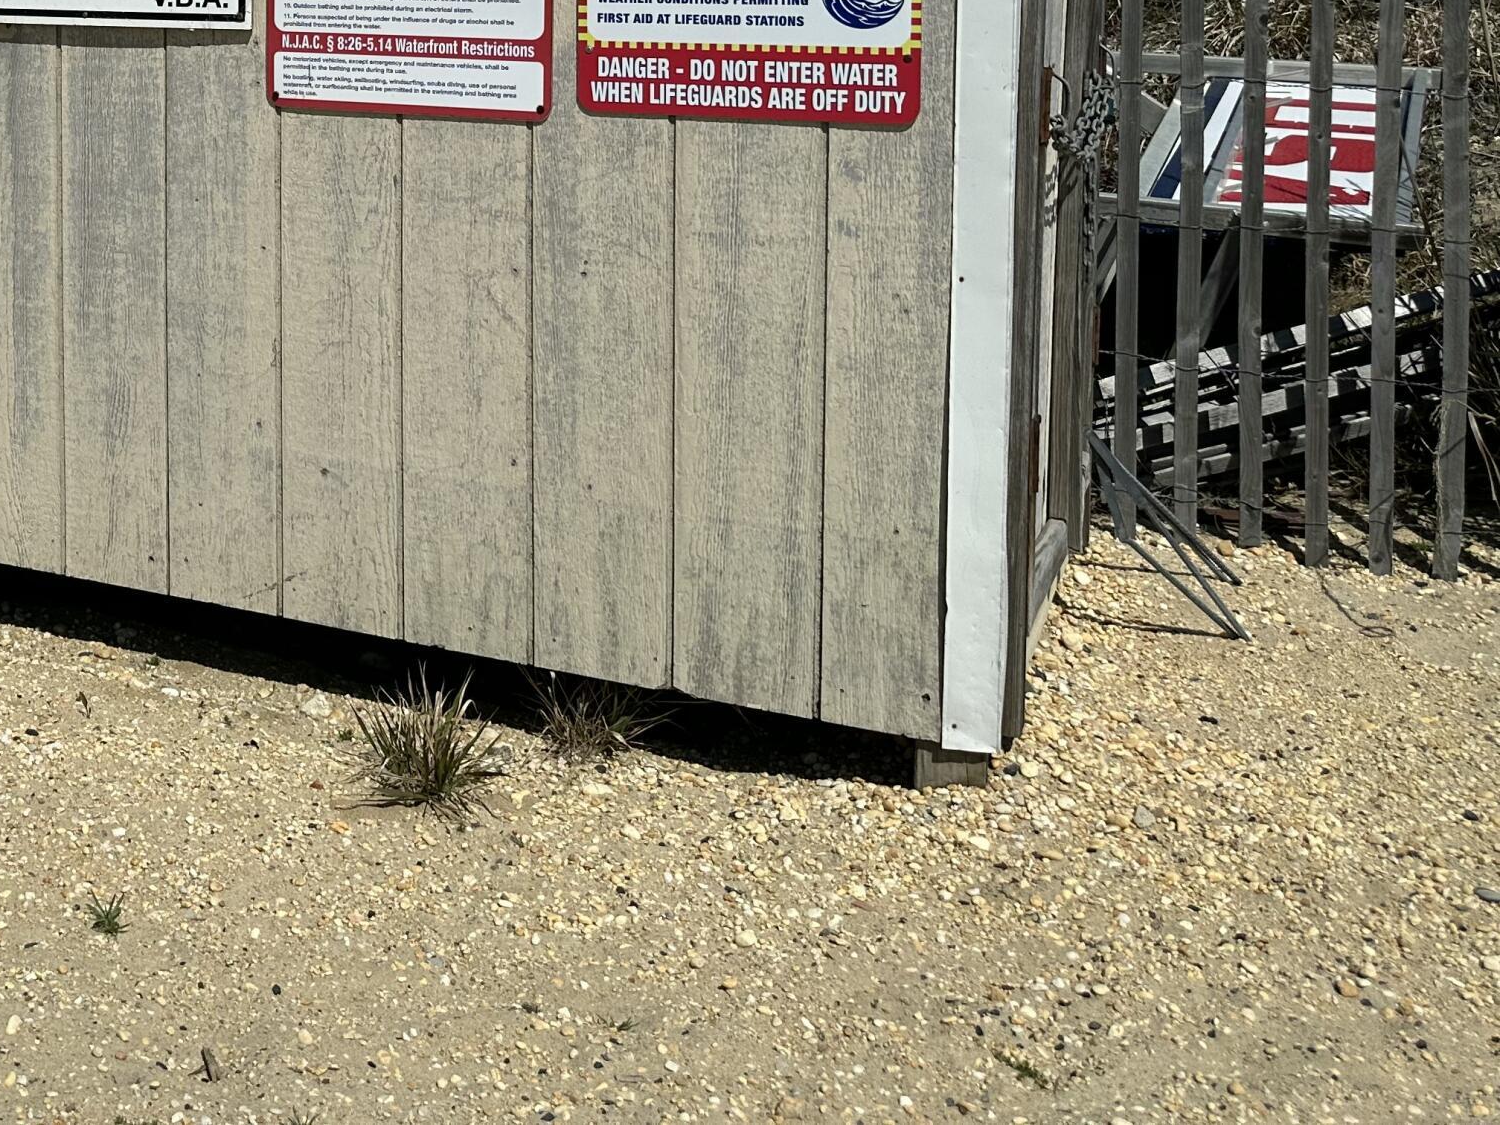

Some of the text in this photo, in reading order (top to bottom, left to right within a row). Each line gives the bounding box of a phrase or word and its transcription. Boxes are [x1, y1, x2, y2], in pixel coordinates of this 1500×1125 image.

[597, 13, 805, 27] FIRST AID AT LIFEGUARD STATIONS
[282, 34, 535, 58] N.J.A.C. § 8:26-5.14 Waterfront Restrictions
[598, 56, 670, 79] DANGER
[690, 59, 715, 81] DO
[721, 60, 759, 82] NOT
[764, 61, 825, 84] ENTER
[830, 62, 897, 87] WATER
[591, 81, 906, 114] WHEN LIFEGUARDS ARE OFF DUTY
